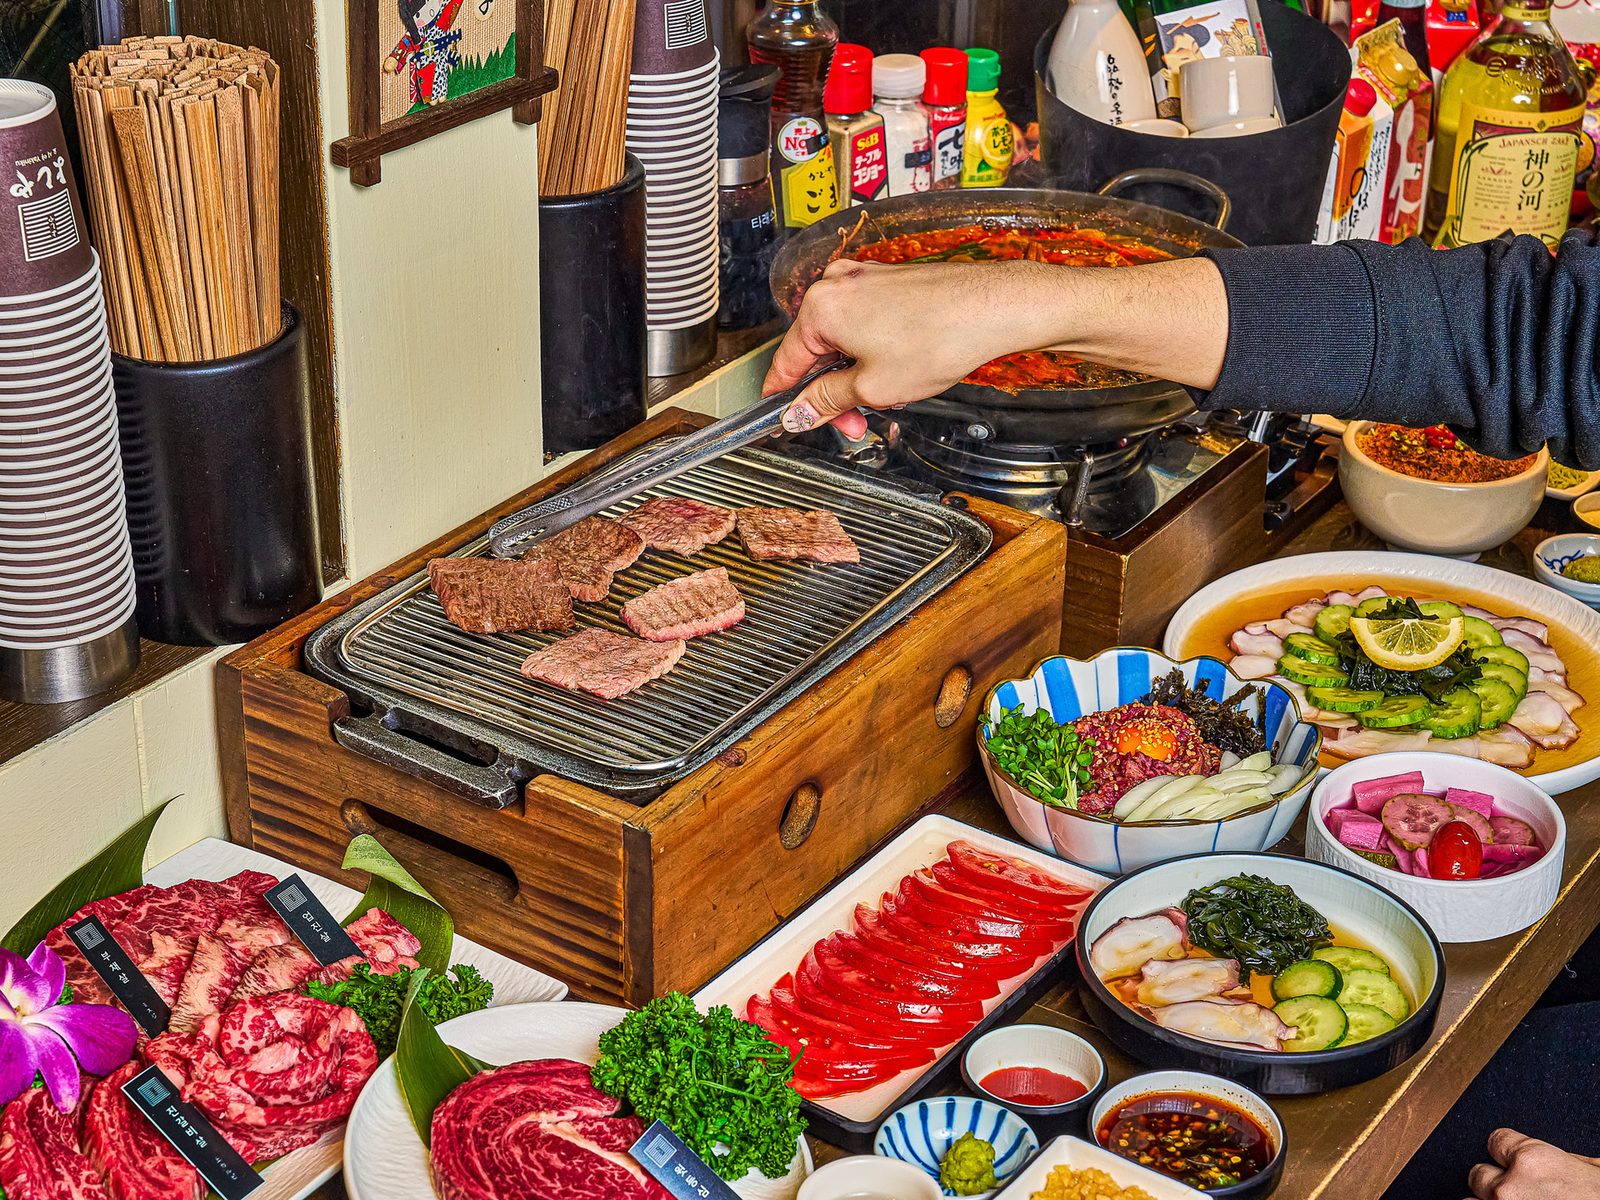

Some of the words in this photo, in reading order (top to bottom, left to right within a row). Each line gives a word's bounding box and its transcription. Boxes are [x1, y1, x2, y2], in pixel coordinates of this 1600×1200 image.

[856, 132, 879, 151] S&B
[10, 156, 66, 198] よしや
[853, 164, 884, 188] コショー
[1518, 149, 1550, 211] 神の河
[302, 910, 331, 943] 업진살
[100, 951, 130, 984] 부채살
[166, 1105, 208, 1149] 진갈비살
